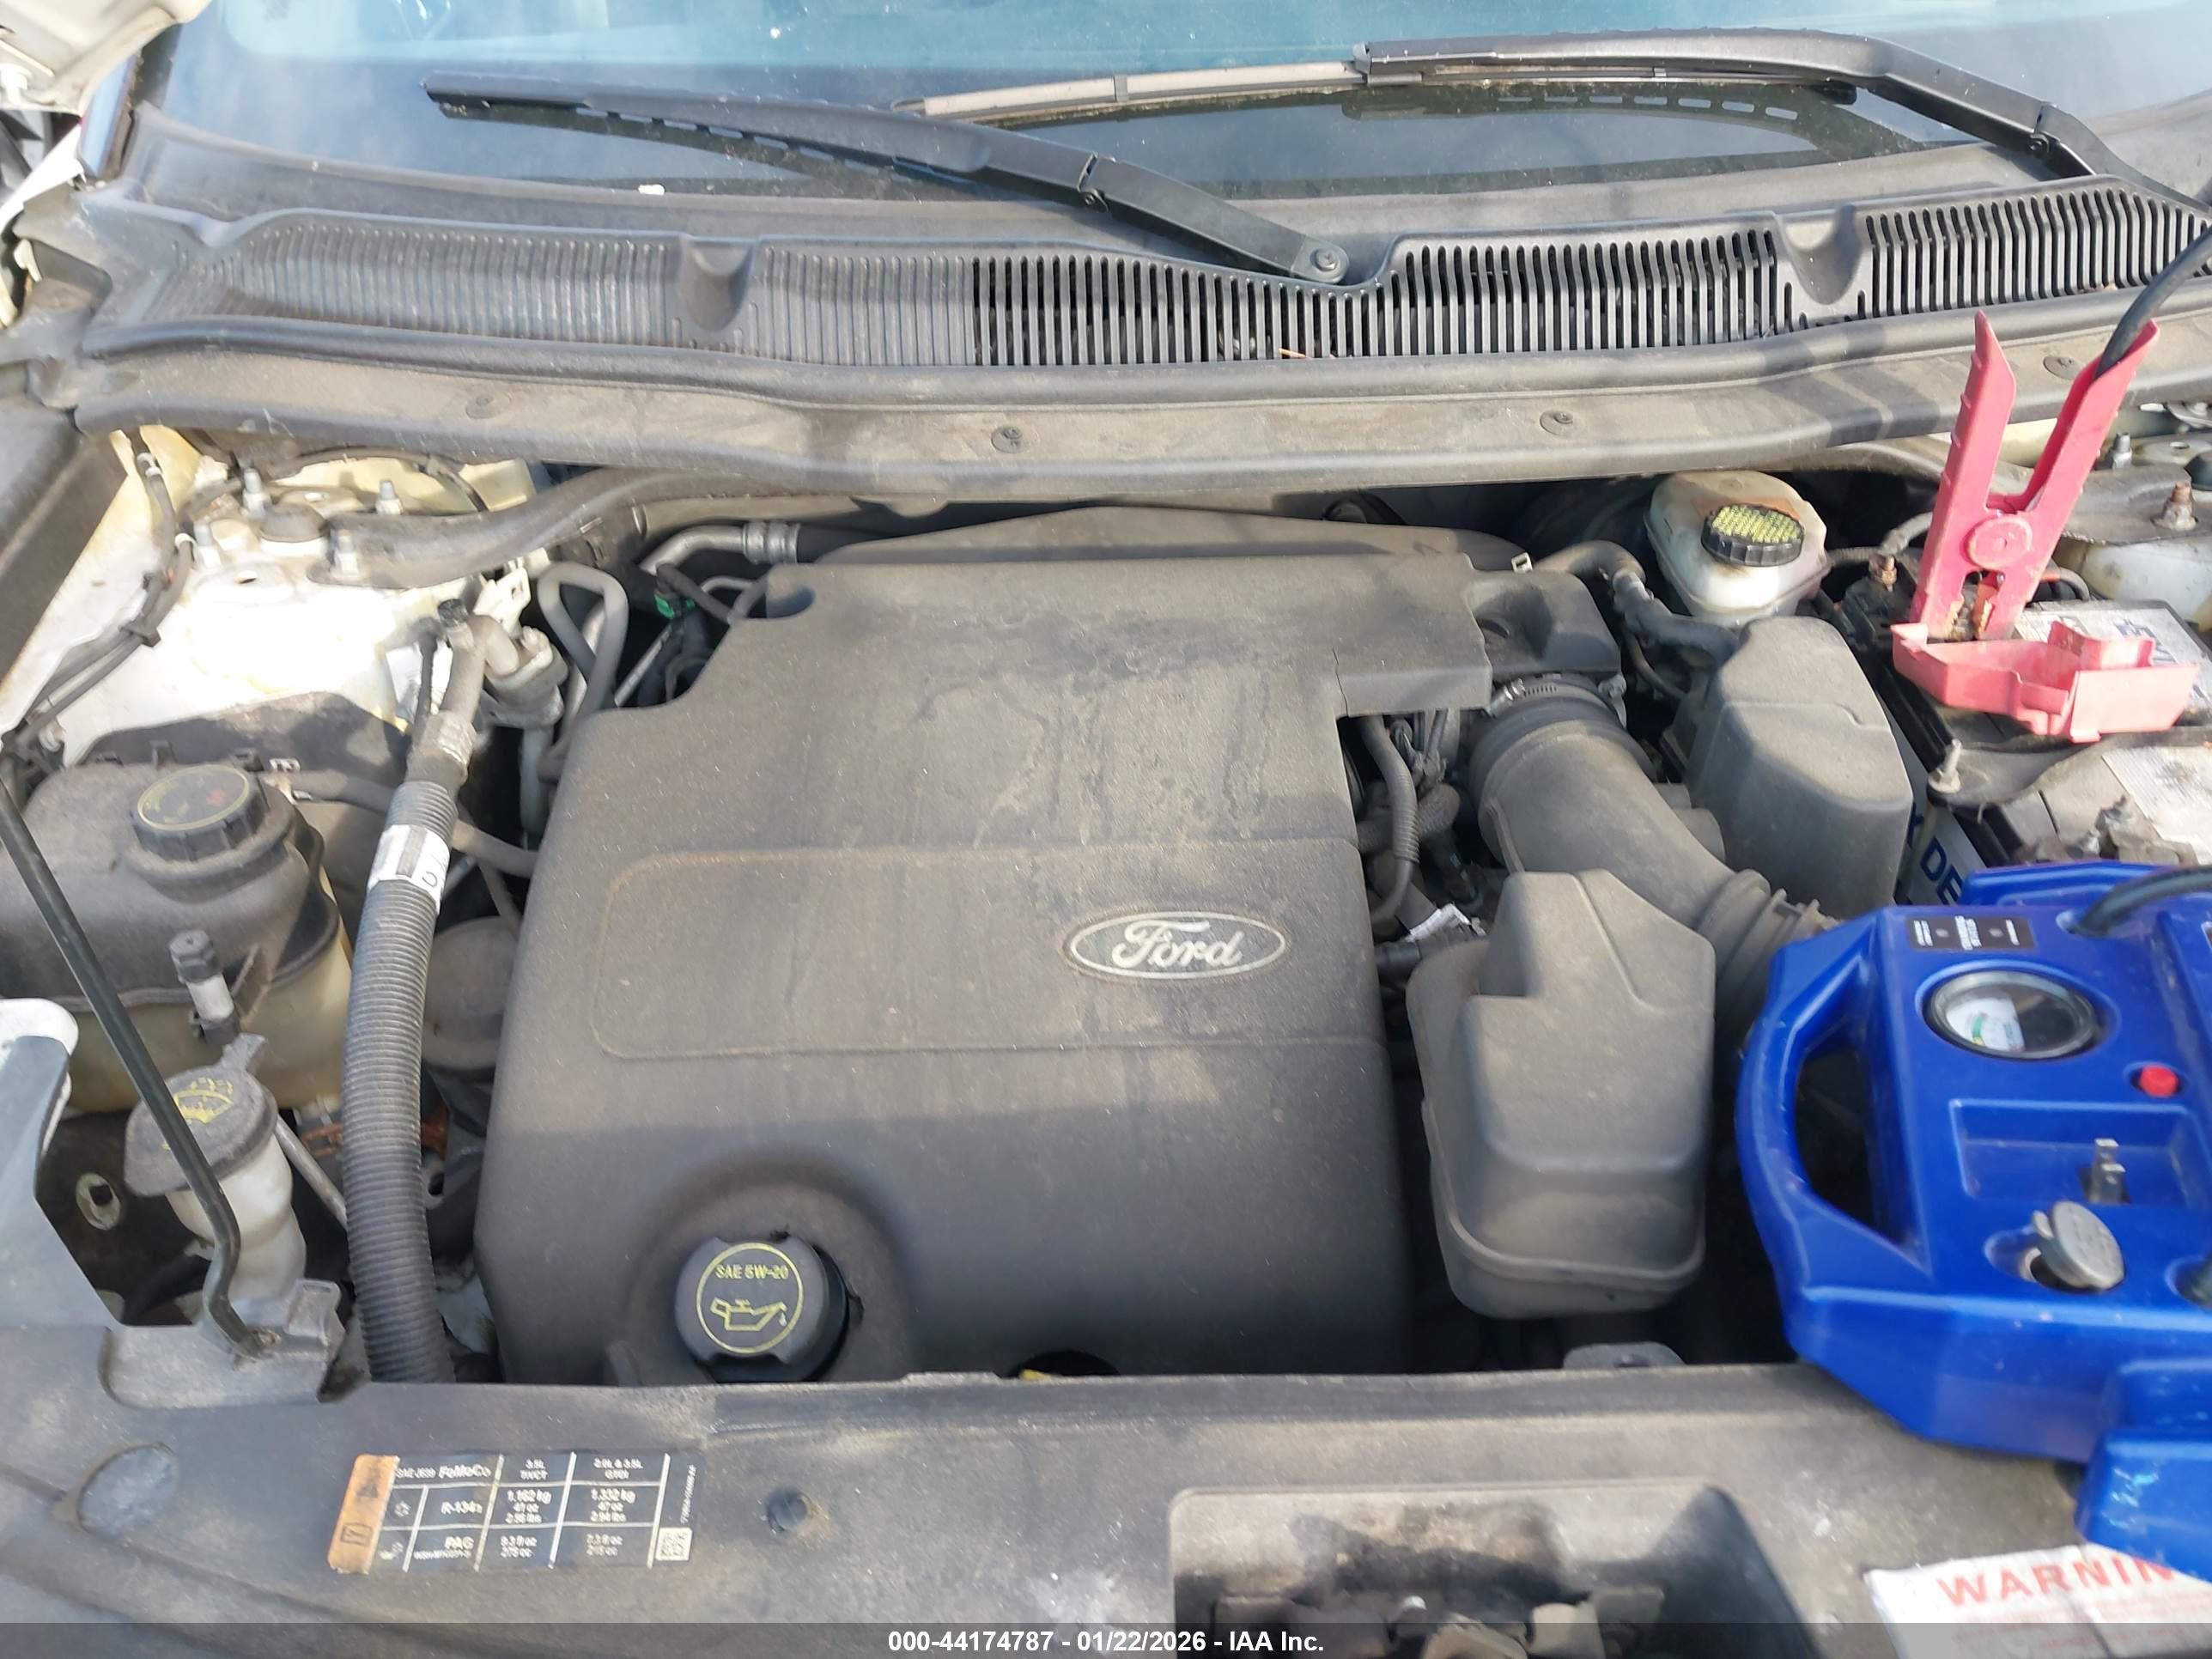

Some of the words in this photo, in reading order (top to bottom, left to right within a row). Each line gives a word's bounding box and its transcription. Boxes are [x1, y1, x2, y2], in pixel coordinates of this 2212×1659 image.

[1112, 919, 1244, 969] Ford
[714, 1264, 743, 1279] SAE
[438, 1464, 491, 1479] FoMoCo
[537, 1489, 552, 1504] kg
[621, 1488, 635, 1504] kg
[441, 1501, 483, 1515] R-134a
[445, 1536, 475, 1550] PAG
